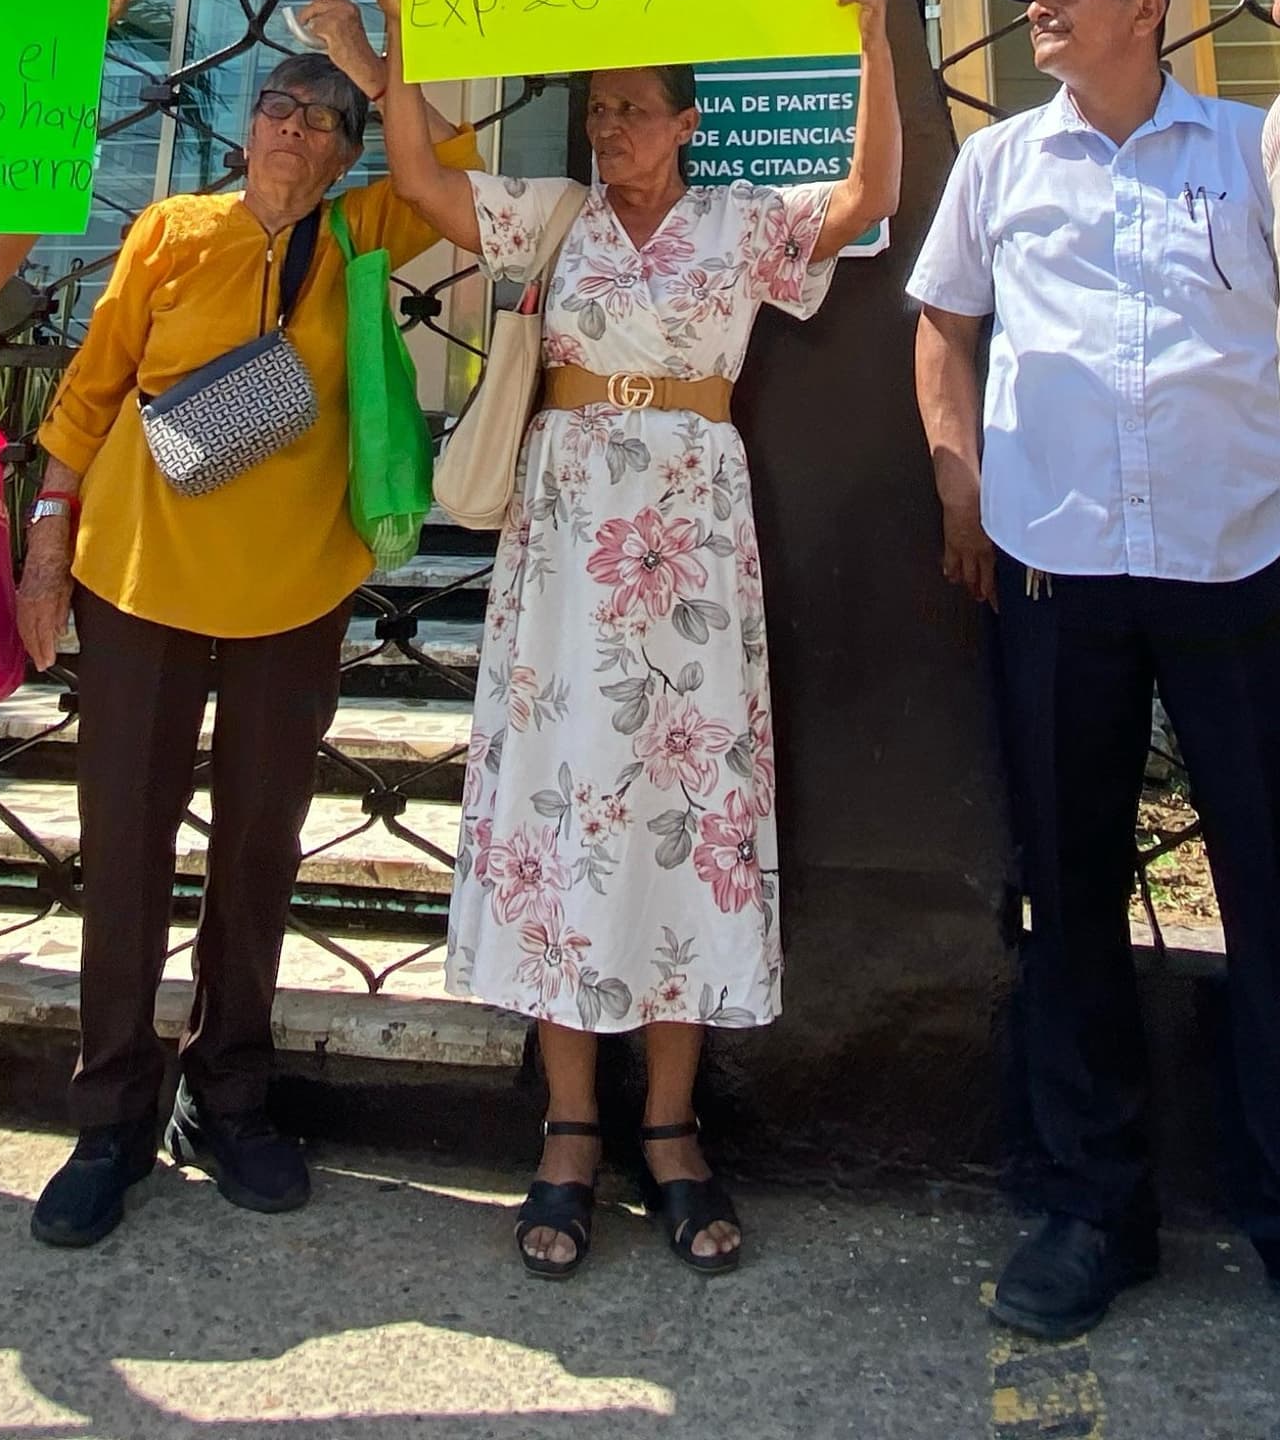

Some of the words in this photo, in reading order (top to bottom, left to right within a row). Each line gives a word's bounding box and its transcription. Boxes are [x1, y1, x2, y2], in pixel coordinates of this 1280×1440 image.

[18, 38, 59, 81] el
[741, 96, 769, 113] DE
[776, 93, 853, 111] PARTES
[692, 130, 719, 147] DE
[726, 126, 856, 147] AUDIENCIAS
[750, 157, 840, 176] CITADAS
